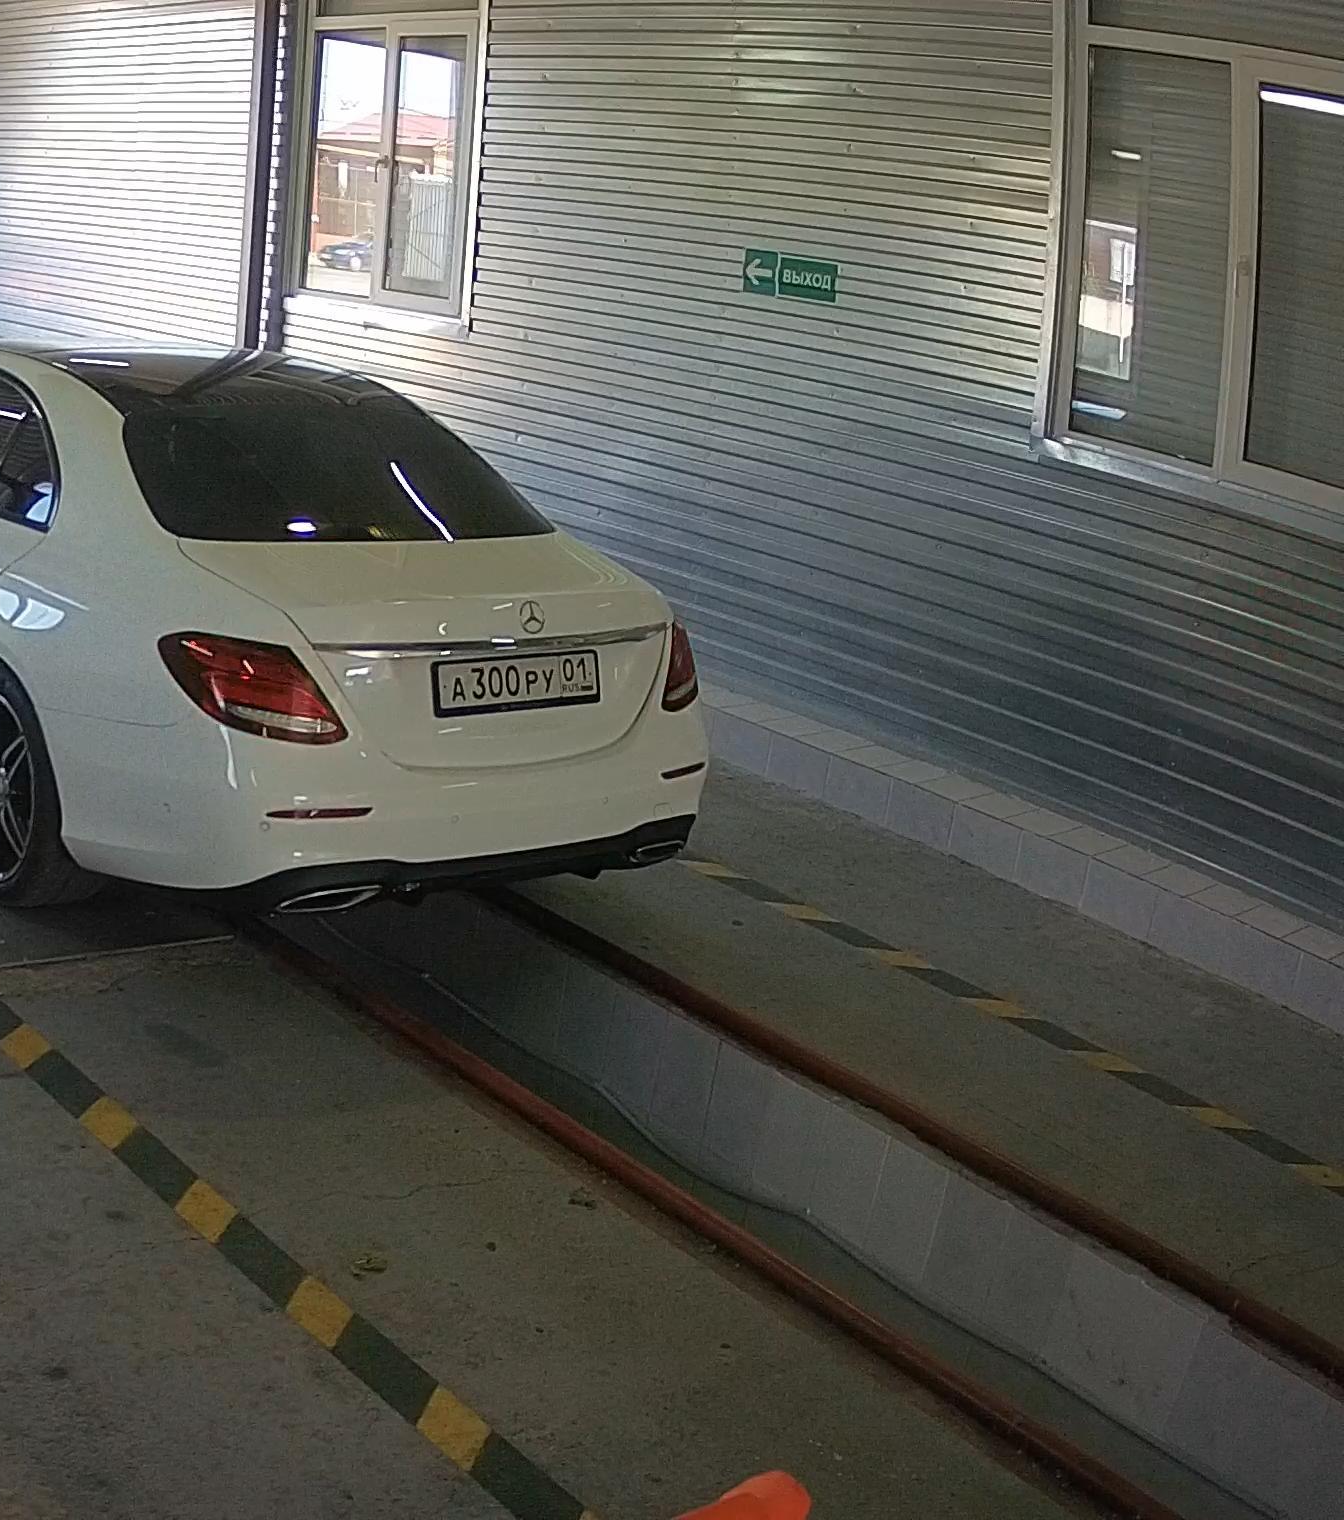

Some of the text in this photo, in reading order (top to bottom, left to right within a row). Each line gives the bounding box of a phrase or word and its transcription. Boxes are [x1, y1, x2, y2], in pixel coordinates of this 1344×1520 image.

[782, 268, 832, 291] ВЫХОД
[452, 657, 587, 702] А300РУ 01
[562, 683, 580, 693] RUS
